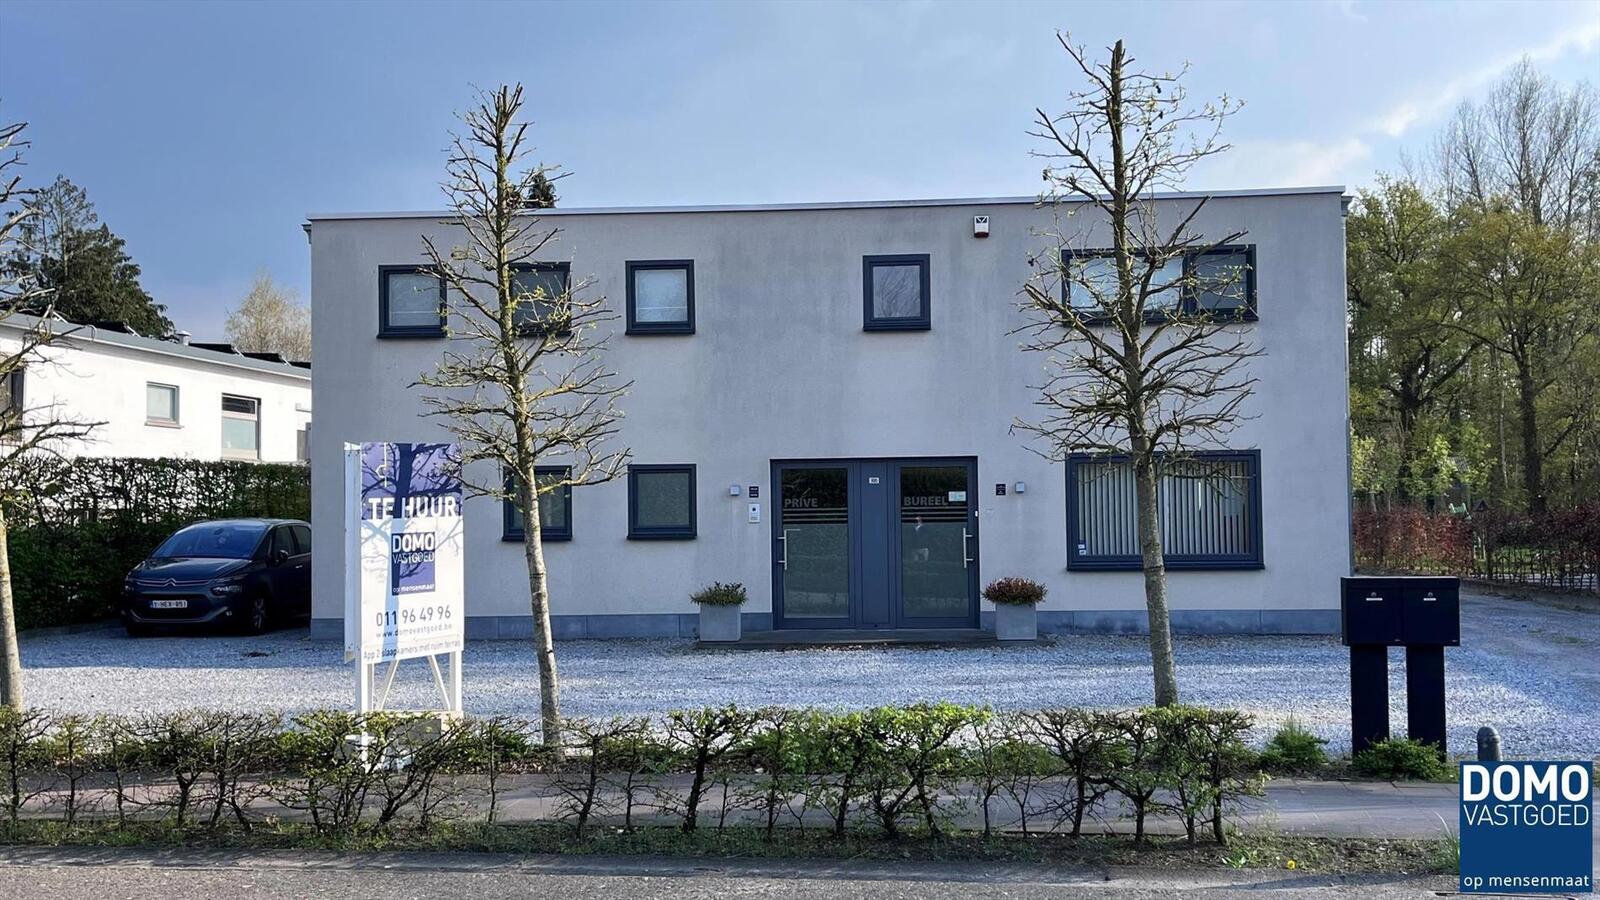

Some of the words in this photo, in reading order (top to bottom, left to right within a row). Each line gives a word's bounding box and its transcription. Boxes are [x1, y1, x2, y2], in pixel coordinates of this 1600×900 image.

[368, 498, 395, 520] TE
[401, 496, 457, 518] HUUR
[903, 496, 948, 506] BUREEL
[392, 533, 435, 553] DOMO
[392, 552, 435, 564] VASTGOED
[376, 610, 397, 627] 011
[402, 609, 416, 624] 96
[420, 606, 433, 621] 49
[437, 605, 451, 620] 96
[376, 623, 452, 638] www.domovastgoed.be
[382, 646, 417, 658] slaapkamers
